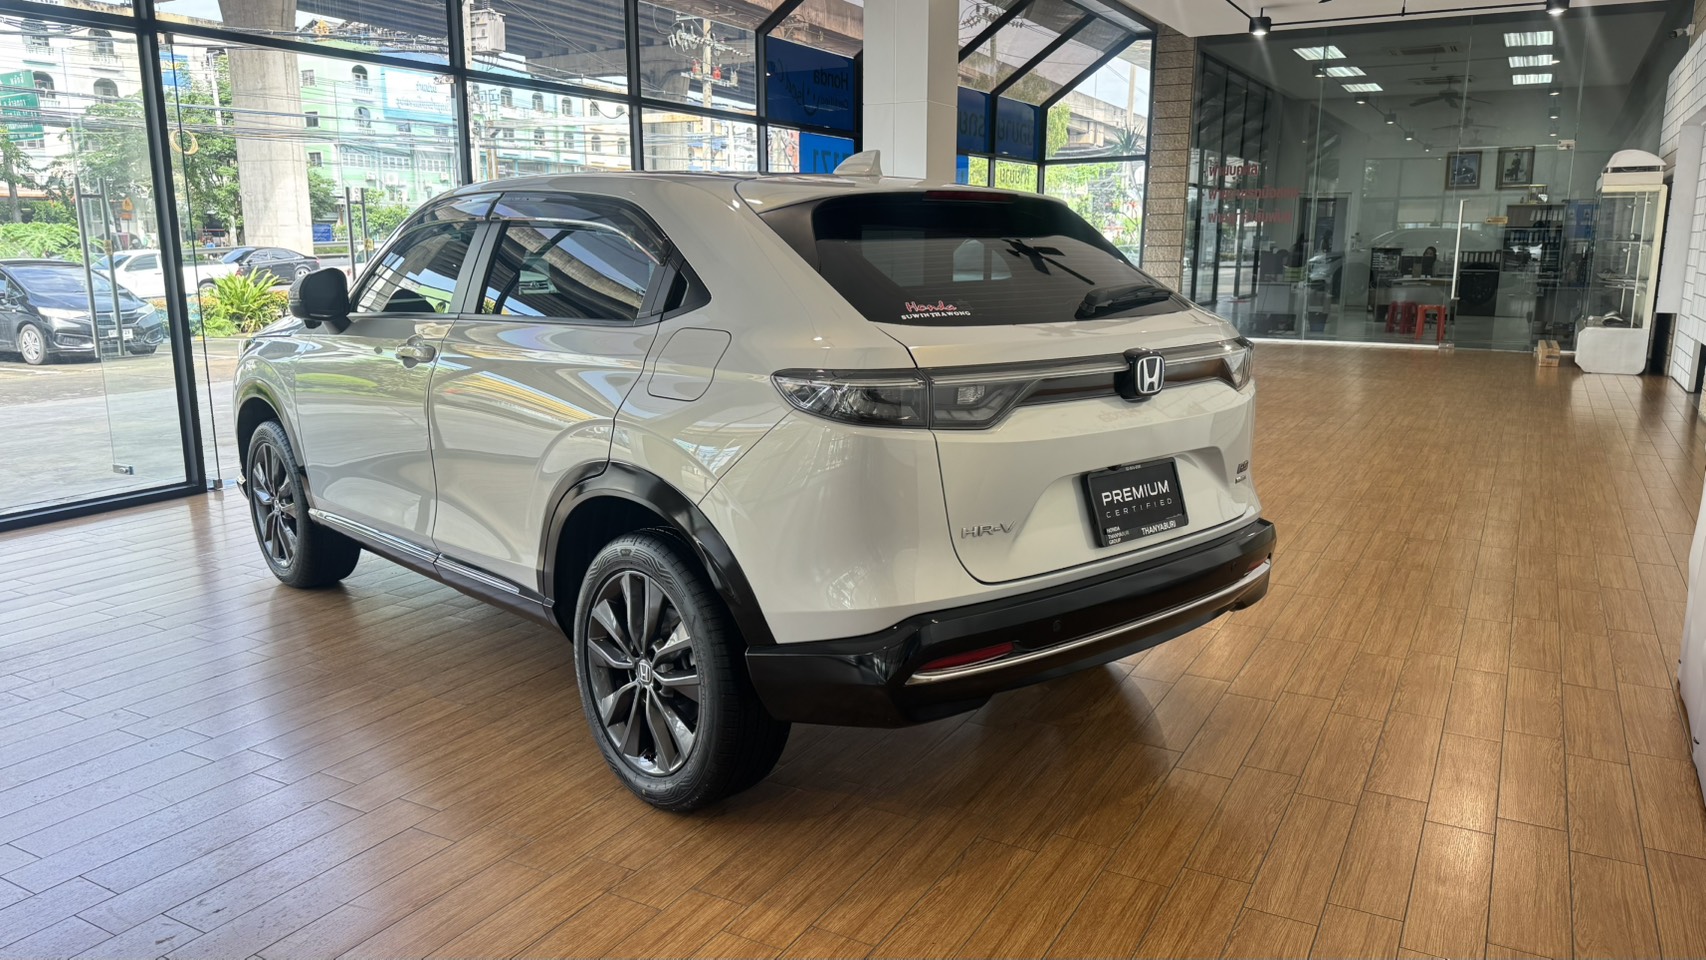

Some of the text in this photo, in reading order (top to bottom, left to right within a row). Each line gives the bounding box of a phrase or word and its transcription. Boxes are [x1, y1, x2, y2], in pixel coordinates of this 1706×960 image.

[904, 299, 958, 313] Honda
[1101, 479, 1170, 506] PREMIUM
[1105, 497, 1173, 519] CERTIFIED
[960, 519, 1016, 539] HR-V
[1140, 519, 1177, 536] THANYABURI
